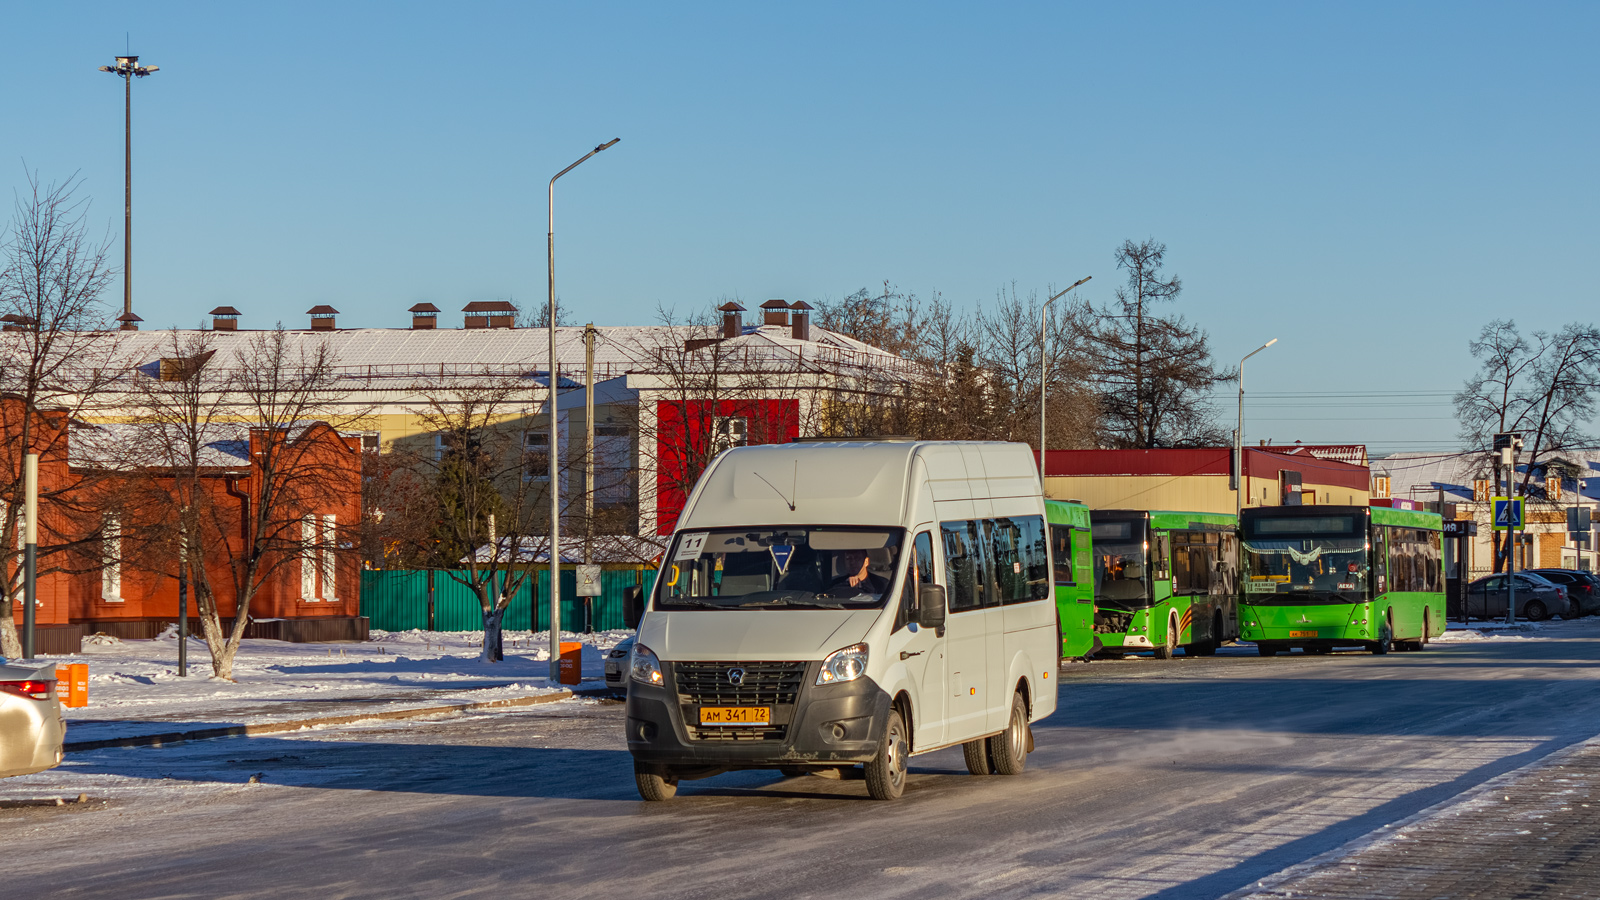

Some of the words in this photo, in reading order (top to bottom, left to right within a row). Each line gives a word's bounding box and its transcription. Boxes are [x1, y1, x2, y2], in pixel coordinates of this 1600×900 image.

[685, 538, 702, 548] 11
[706, 712, 720, 721] АМ
[725, 709, 747, 721] 341
[754, 708, 766, 718] 72
